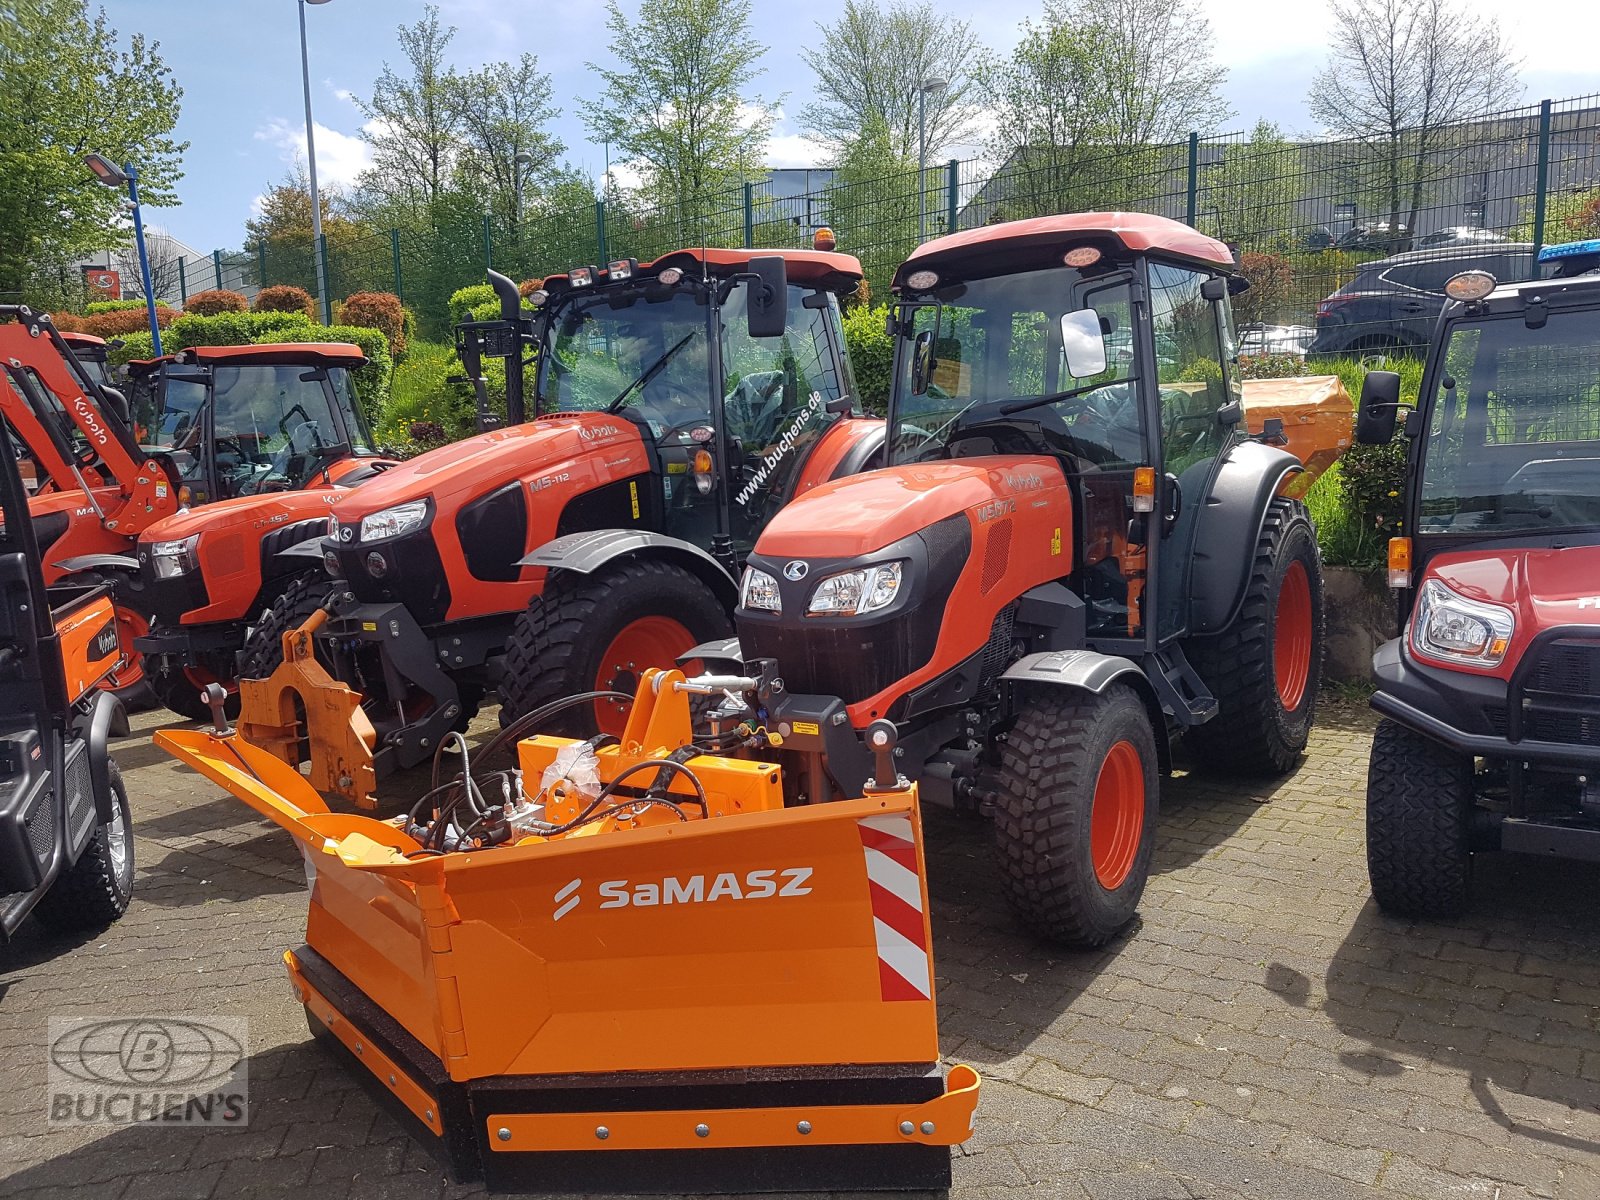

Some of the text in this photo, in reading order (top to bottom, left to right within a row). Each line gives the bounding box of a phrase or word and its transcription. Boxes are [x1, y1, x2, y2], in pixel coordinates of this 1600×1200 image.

[73, 396, 107, 445] Kubota
[577, 424, 618, 440] Kubota
[735, 390, 821, 506] www.buchens.de
[1005, 473, 1045, 491] Kubota
[598, 867, 814, 910] SaMASZ
